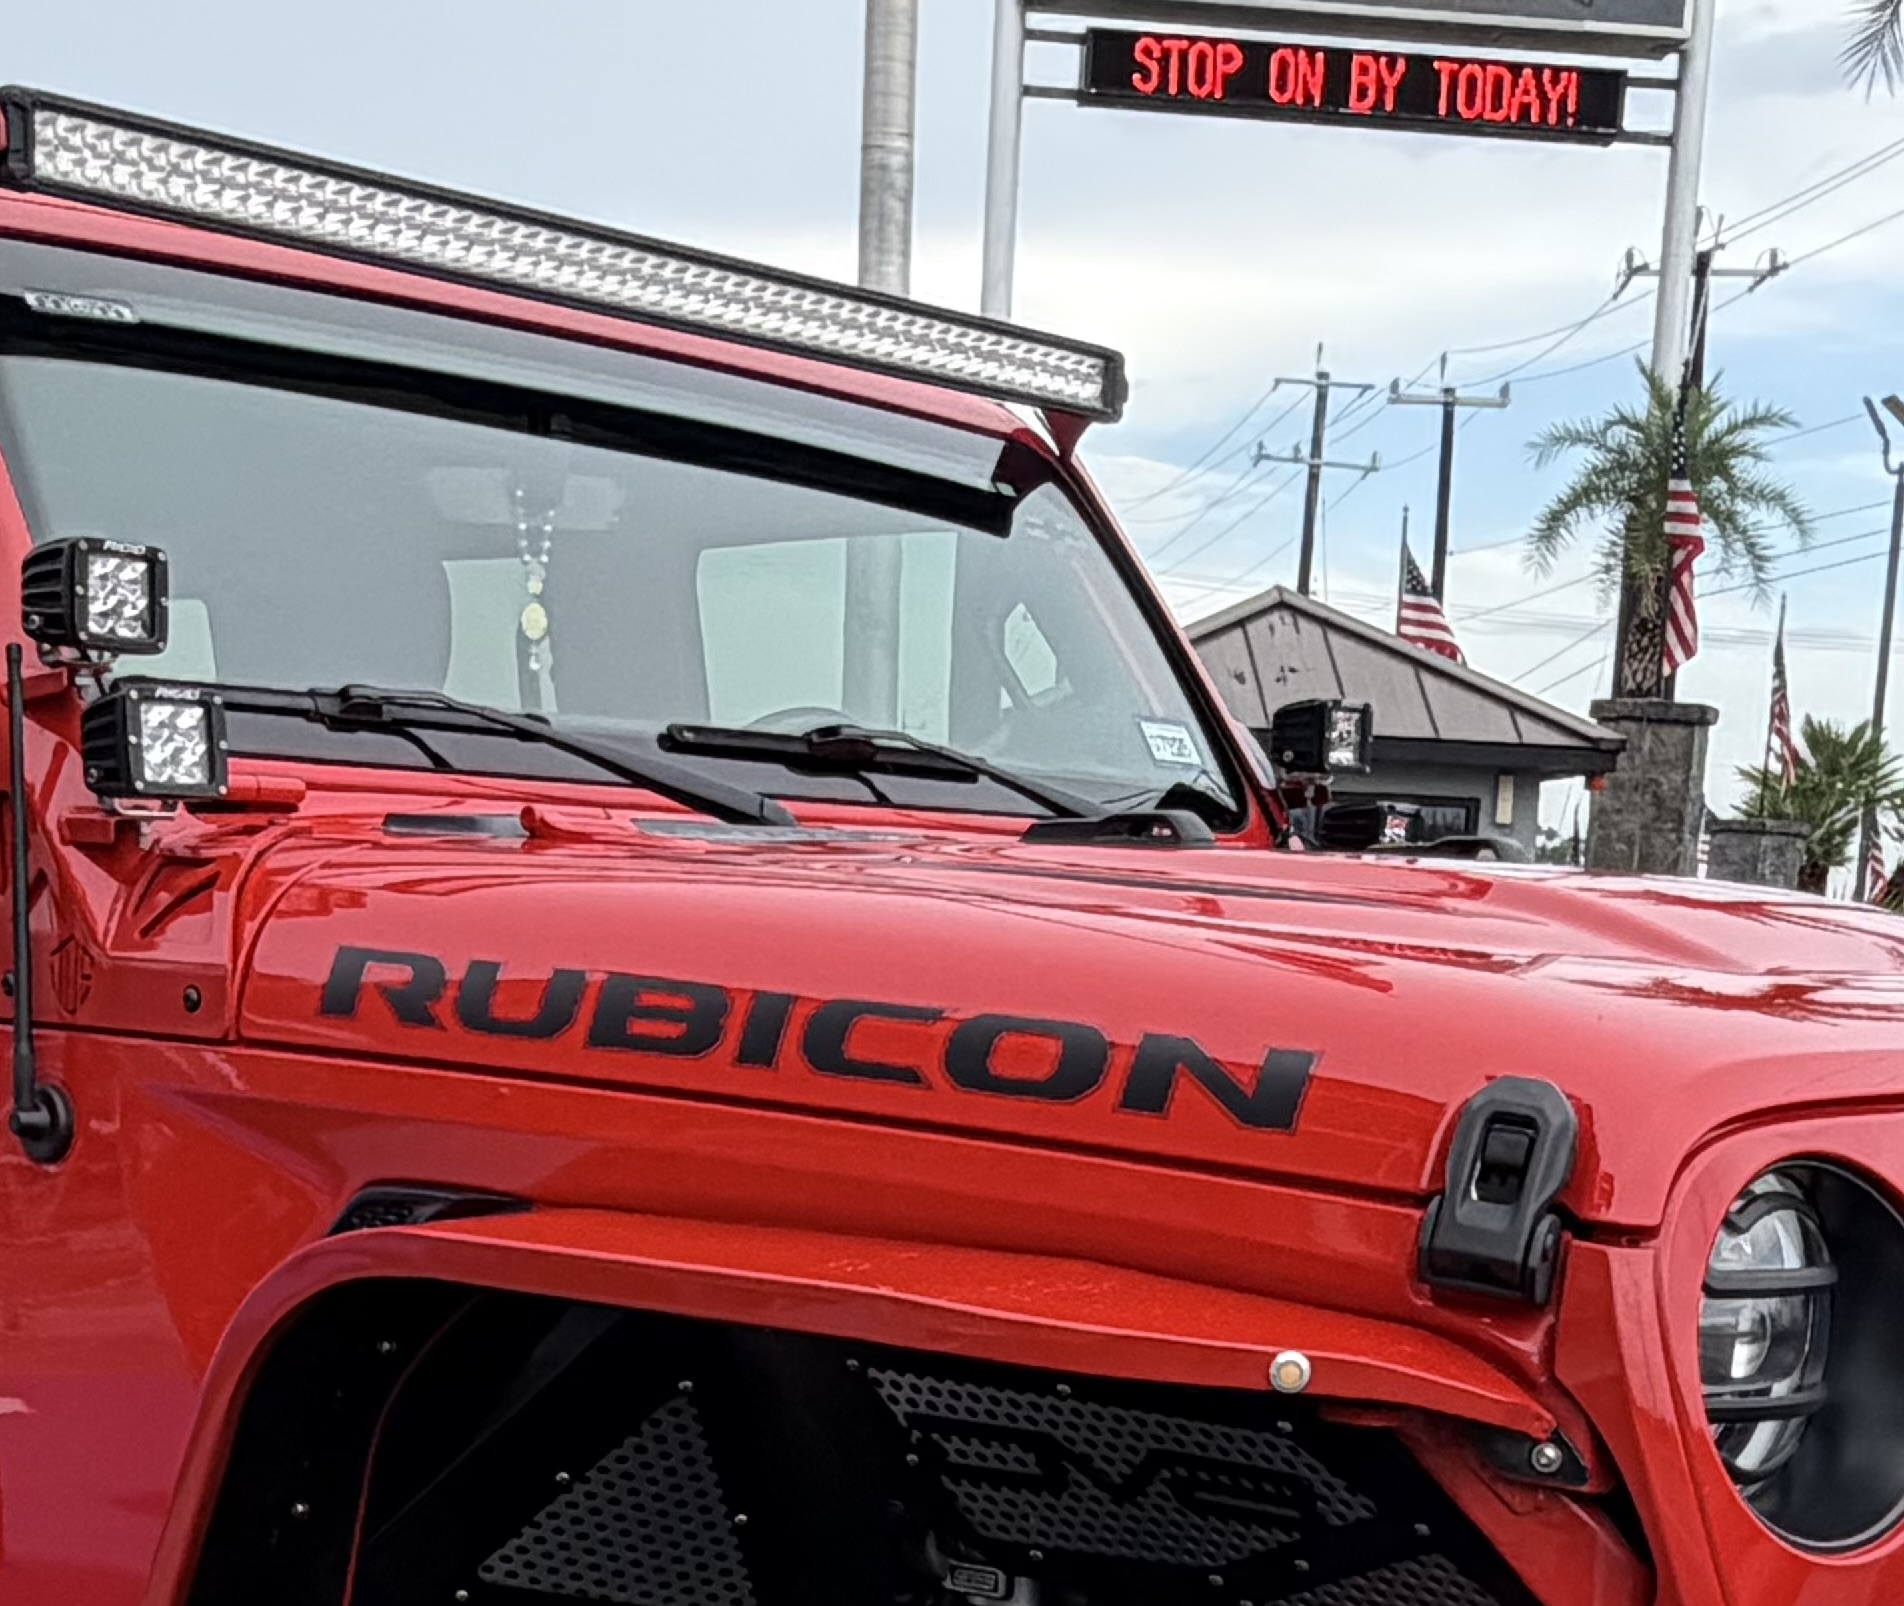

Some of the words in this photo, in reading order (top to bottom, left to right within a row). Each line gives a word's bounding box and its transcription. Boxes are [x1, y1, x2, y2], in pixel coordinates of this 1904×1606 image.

[1132, 36, 1244, 100] STOP
[1268, 48, 1325, 108] ON
[1348, 54, 1406, 114] BY
[1433, 60, 1578, 127] TODAY!
[315, 944, 1324, 1134] RUBICON
